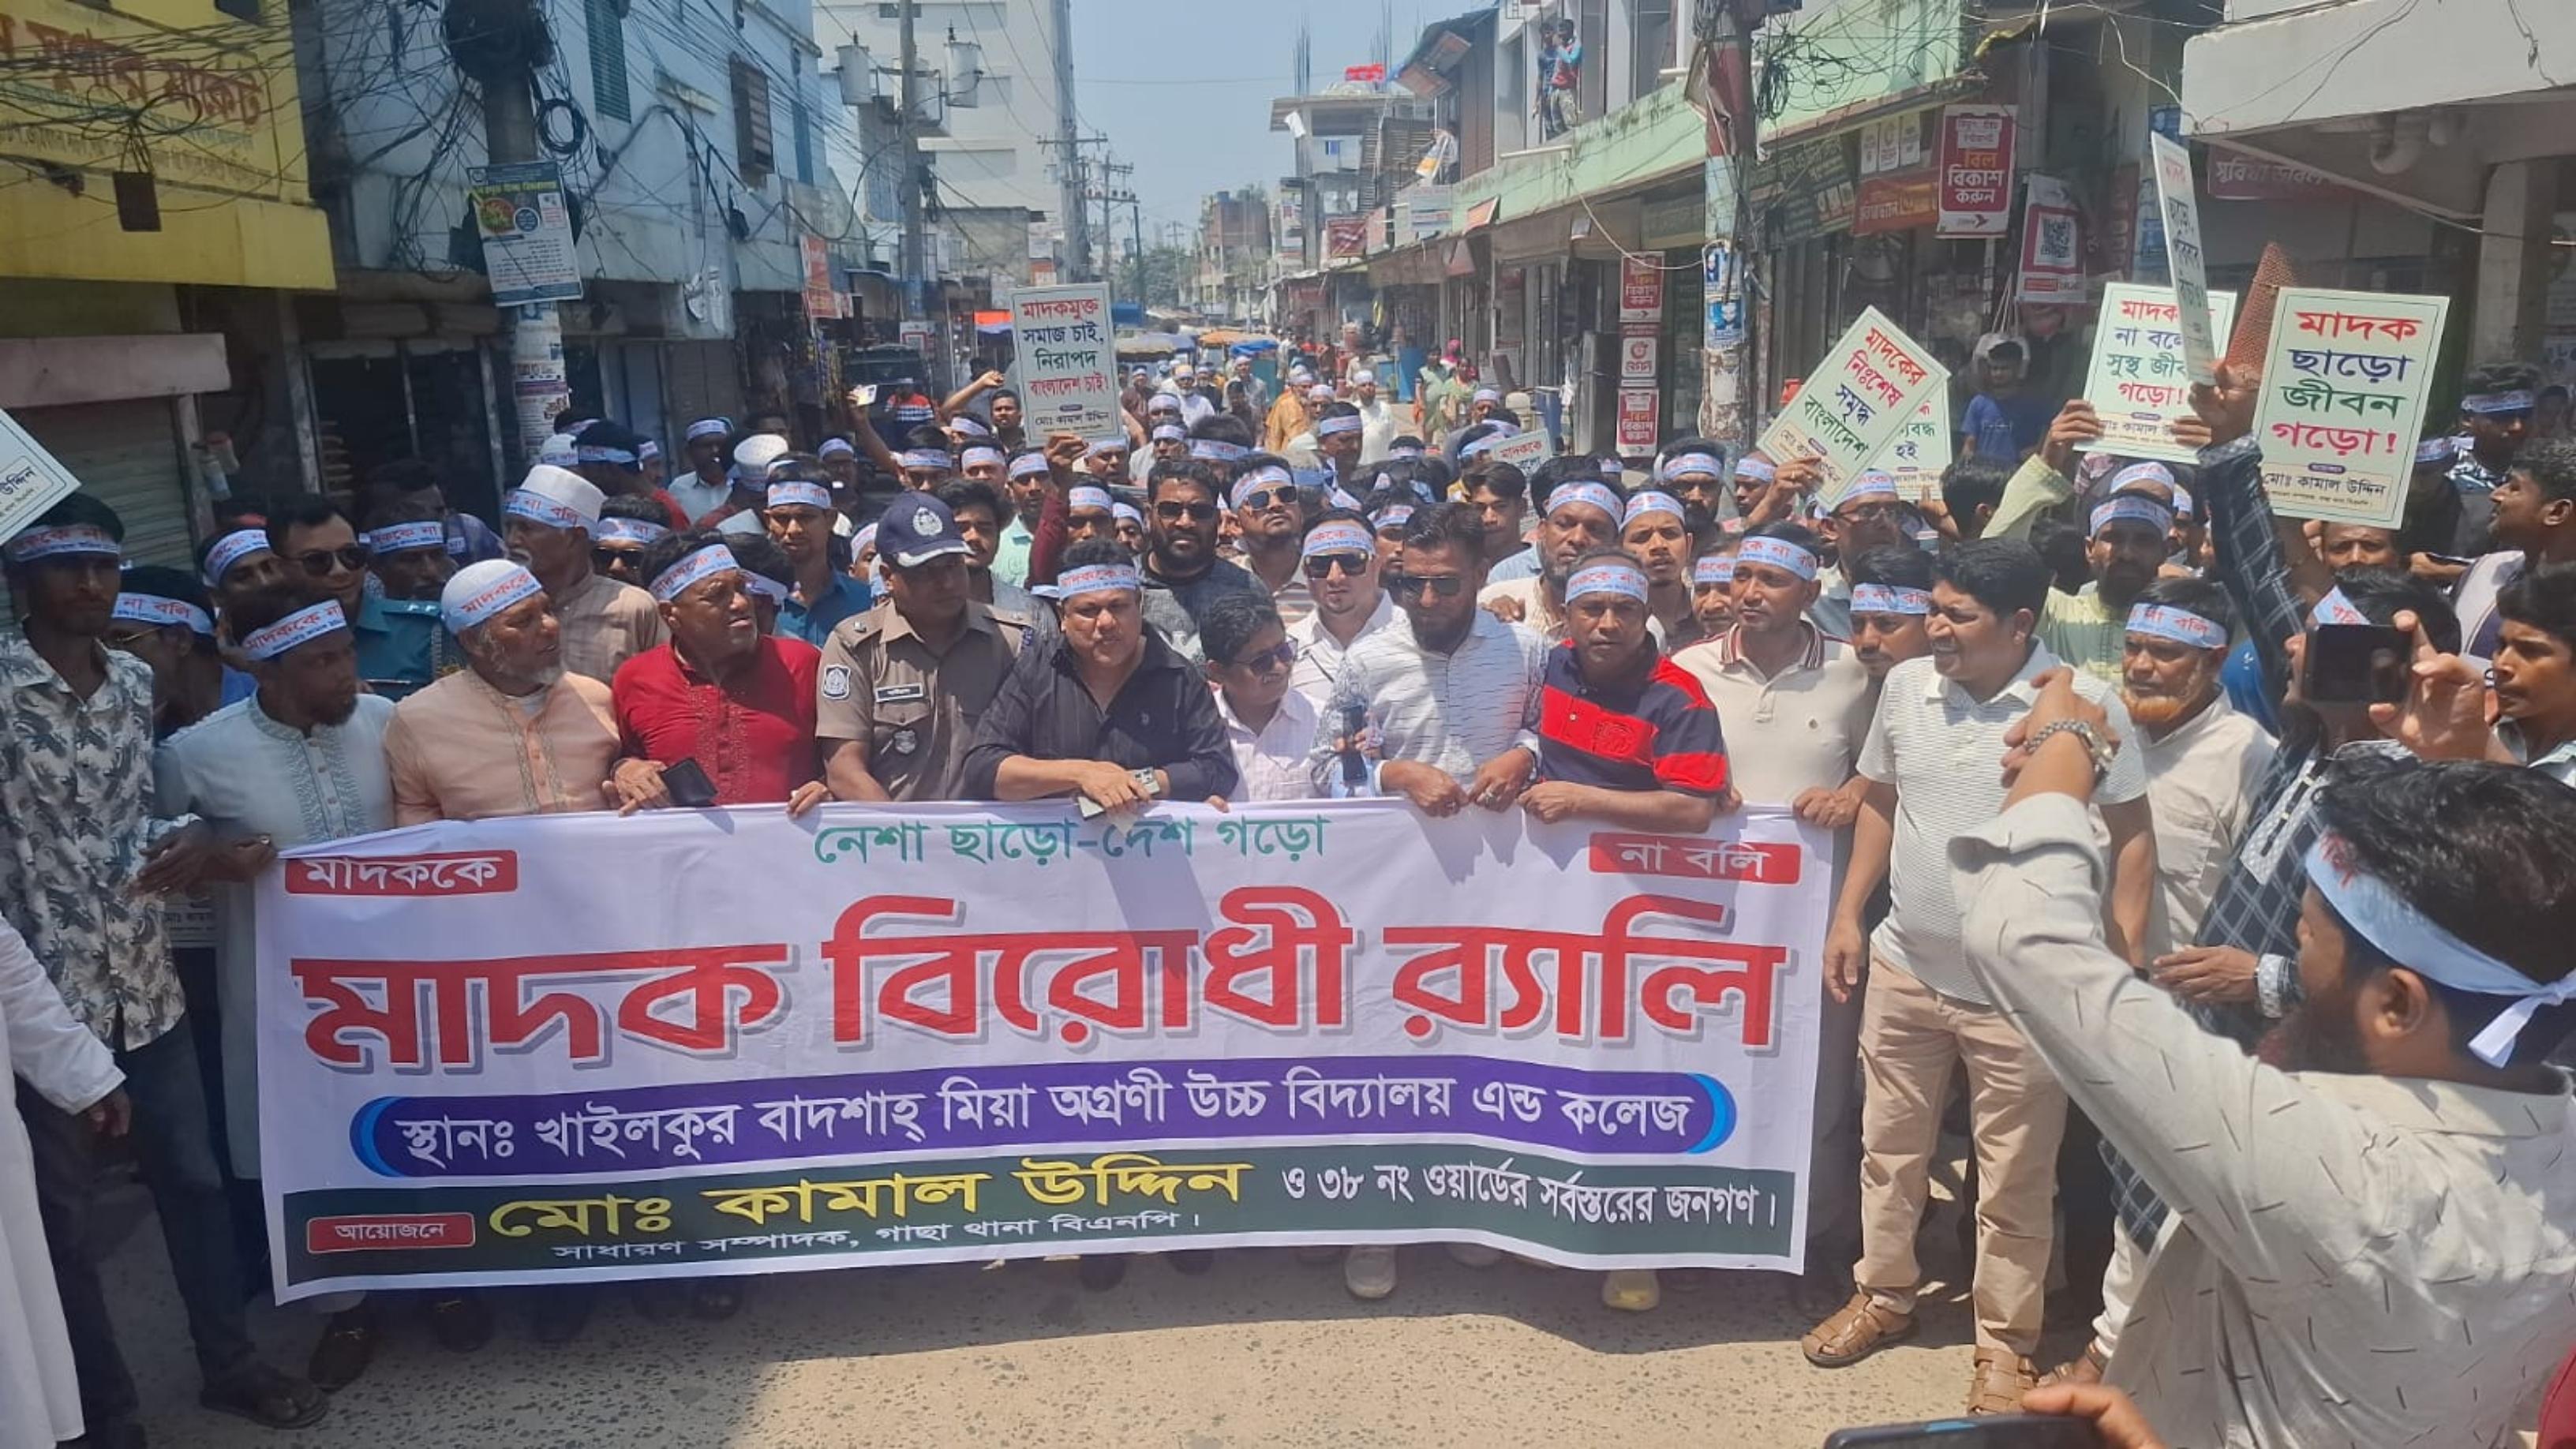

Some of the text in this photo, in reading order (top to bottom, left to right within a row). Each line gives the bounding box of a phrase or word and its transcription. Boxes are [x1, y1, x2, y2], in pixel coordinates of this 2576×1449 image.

[1948, 163, 2005, 186] বিকাশ
[1021, 298, 1099, 320] মাদকমুক্ত
[2294, 311, 2423, 342] মাদক
[1023, 321, 1103, 345] সমাজ চাই,
[2114, 327, 2140, 346] না
[1035, 347, 1098, 371] নিরাপদ
[1865, 327, 1927, 387] মাদকের
[2106, 354, 2141, 379] সুস্থ
[2287, 348, 2415, 384] ছাড়ো
[1029, 378, 1080, 399] বাংলাদেশ
[1844, 350, 1904, 409] নিঃশেষ
[1834, 383, 1877, 427] সমৃদ্ধ
[2280, 378, 2409, 419] জীবন
[1805, 394, 1869, 462] বাংলাদেশ
[814, 821, 930, 864] নেশা
[1217, 814, 1331, 863] গড়ো
[303, 856, 504, 889] মাদককে
[1618, 841, 1772, 878] না বলি
[290, 943, 793, 1067] মাদক
[821, 886, 1356, 1048] বিরোধী
[394, 1114, 515, 1169] স্থানঃ
[535, 1100, 743, 1162] খাইলকুর
[753, 1088, 927, 1144] বাদশাহ্
[937, 1076, 1036, 1132] মিয়া
[1046, 1067, 1174, 1125] অগ্রণী
[1184, 1069, 1272, 1118] উচ্চ
[1282, 1065, 1458, 1119] বিদ্যালয়
[1557, 1090, 1695, 1136] কলেজ
[489, 1152, 1256, 1237] মোঃ কামাল উদ্দিন
[1282, 1166, 1306, 1200] ও
[1316, 1165, 1365, 1201] ৩৮
[1373, 1163, 1414, 1204] নং
[1423, 1157, 1531, 1210] ওয়ার্ডের
[1537, 1171, 1658, 1225] সর্বস্তরের
[334, 1221, 448, 1242] আয়োজনে
[551, 1238, 687, 1262] সাধারণ
[698, 1229, 860, 1254] সম্পাদক,
[875, 1222, 950, 1243] গাছা
[964, 1217, 1039, 1237] থানা
[1048, 1208, 1181, 1234] বিএনপি
